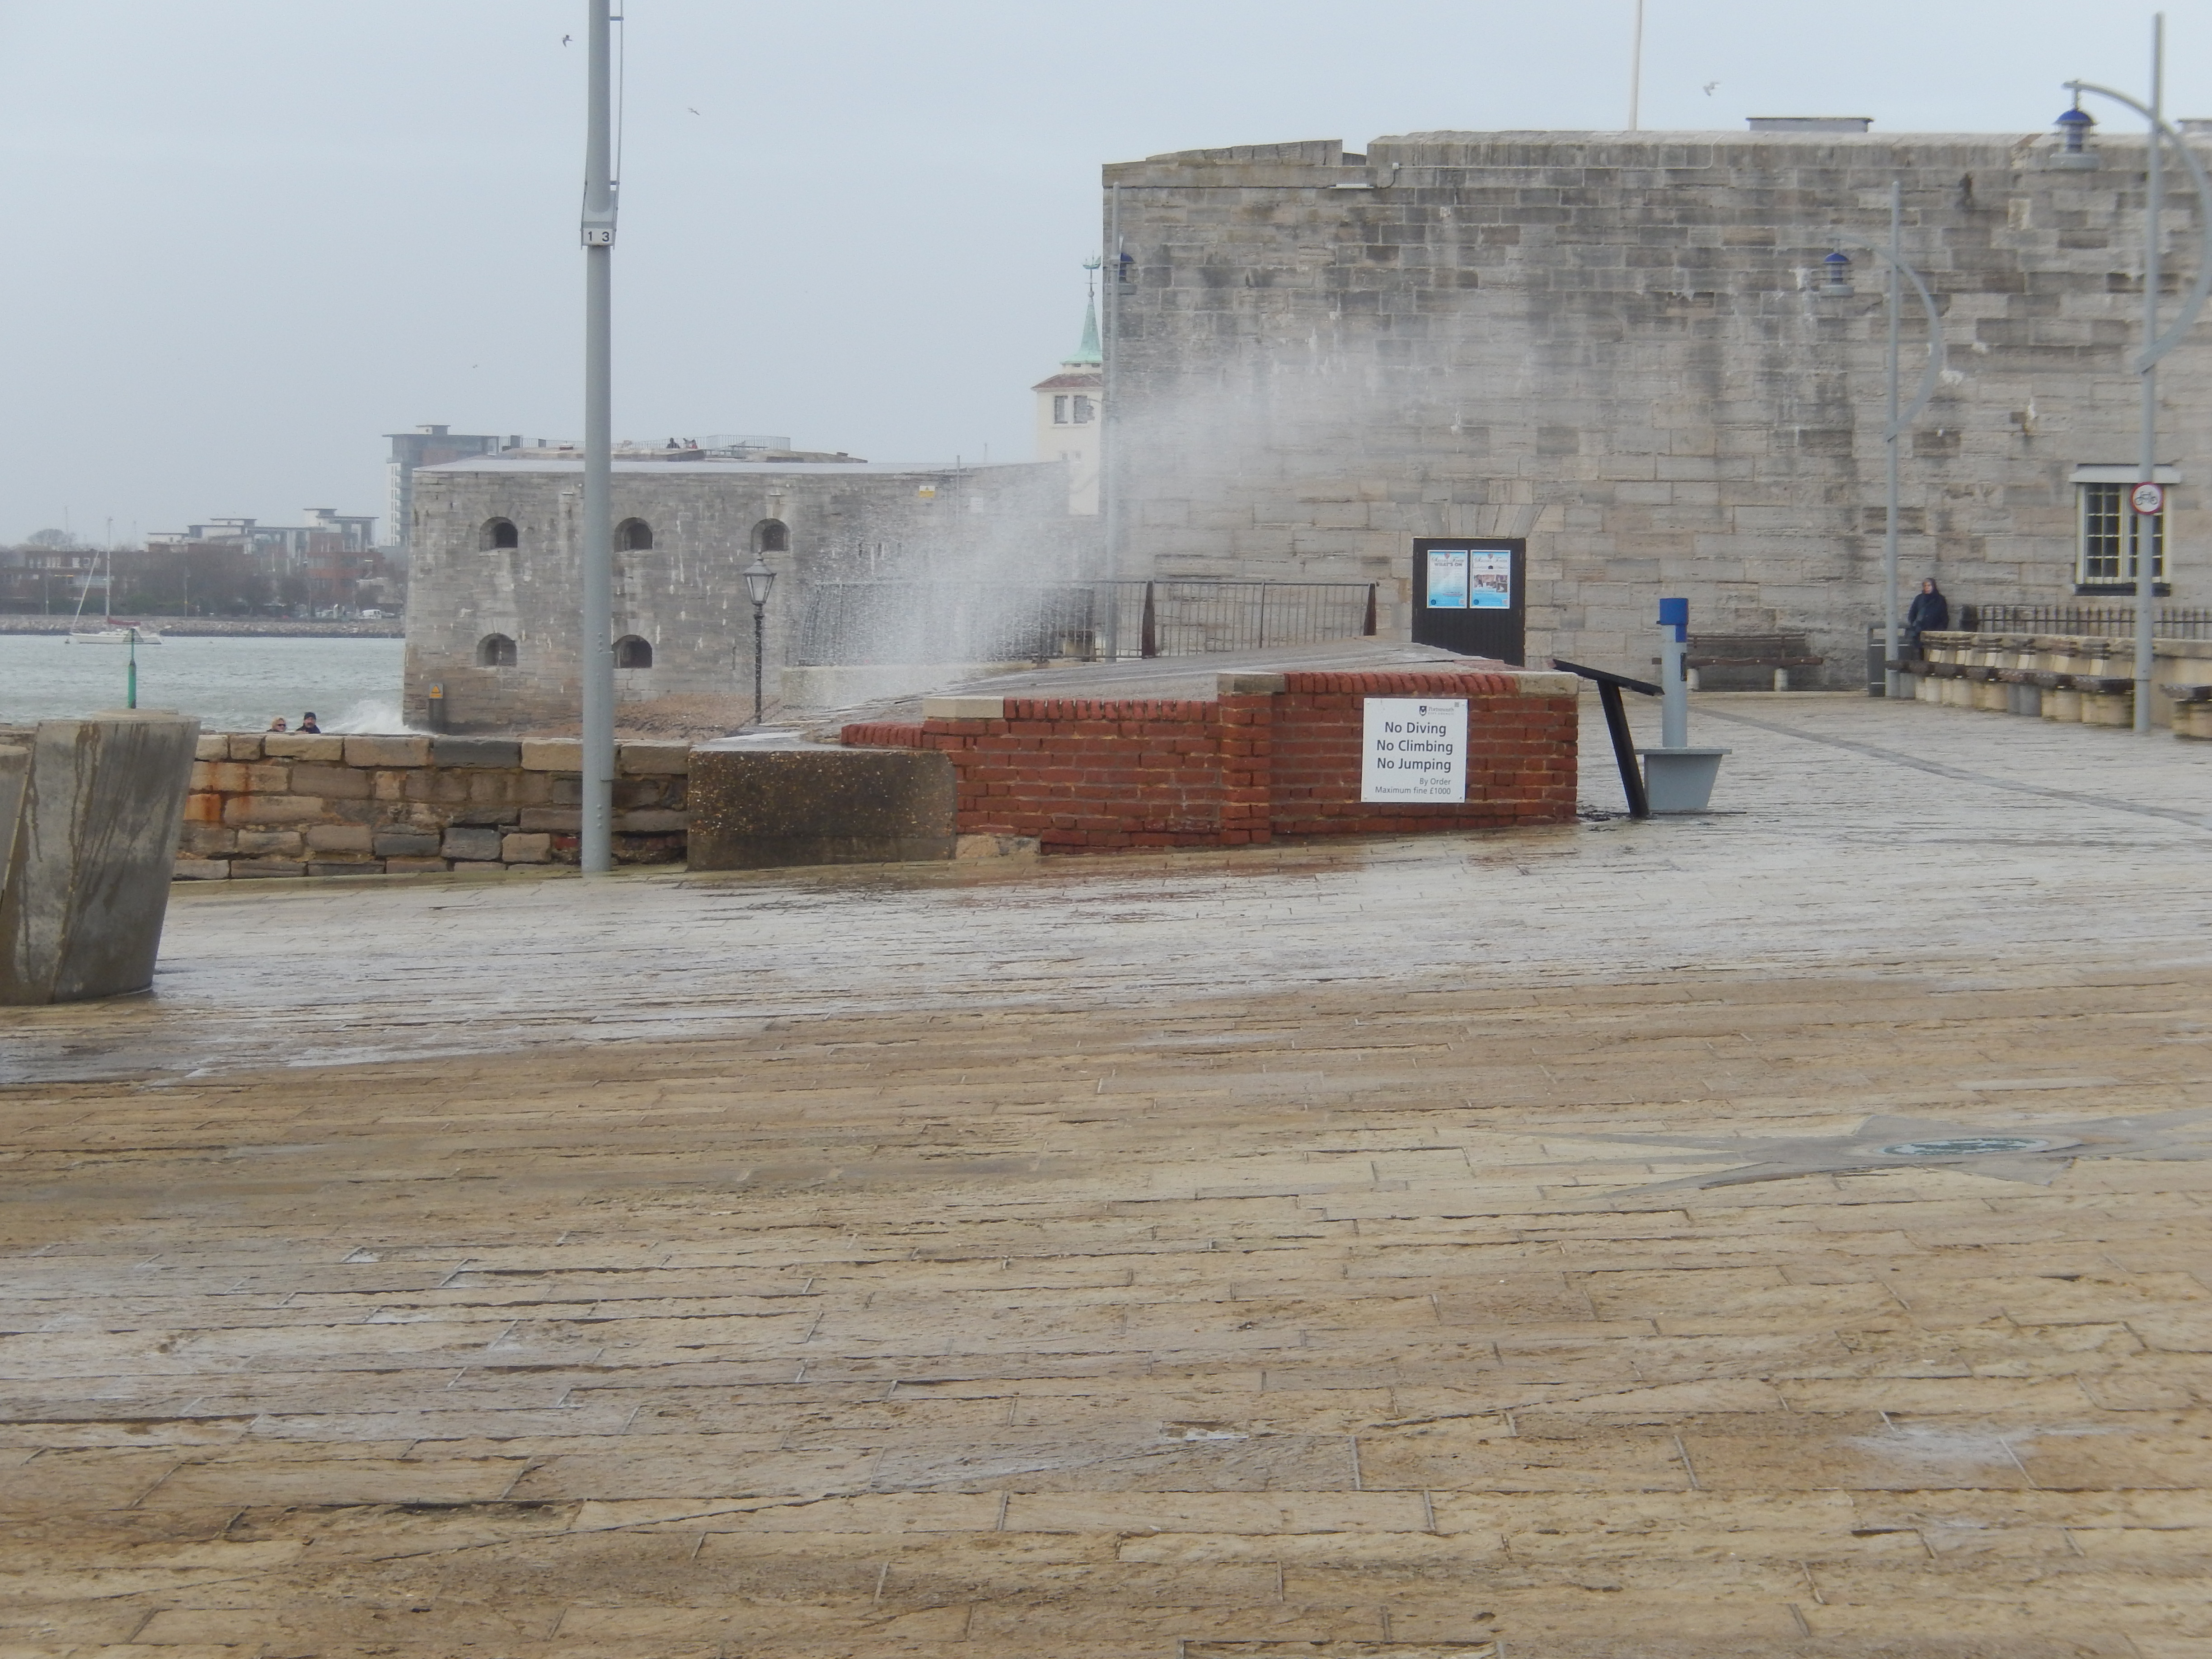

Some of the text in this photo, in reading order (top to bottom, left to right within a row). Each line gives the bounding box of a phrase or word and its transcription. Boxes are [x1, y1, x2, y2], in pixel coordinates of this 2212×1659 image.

[1386, 722, 1446, 737] No Diving
[1377, 740, 1453, 755] No Climbing
[1378, 758, 1451, 773] No Jumping
